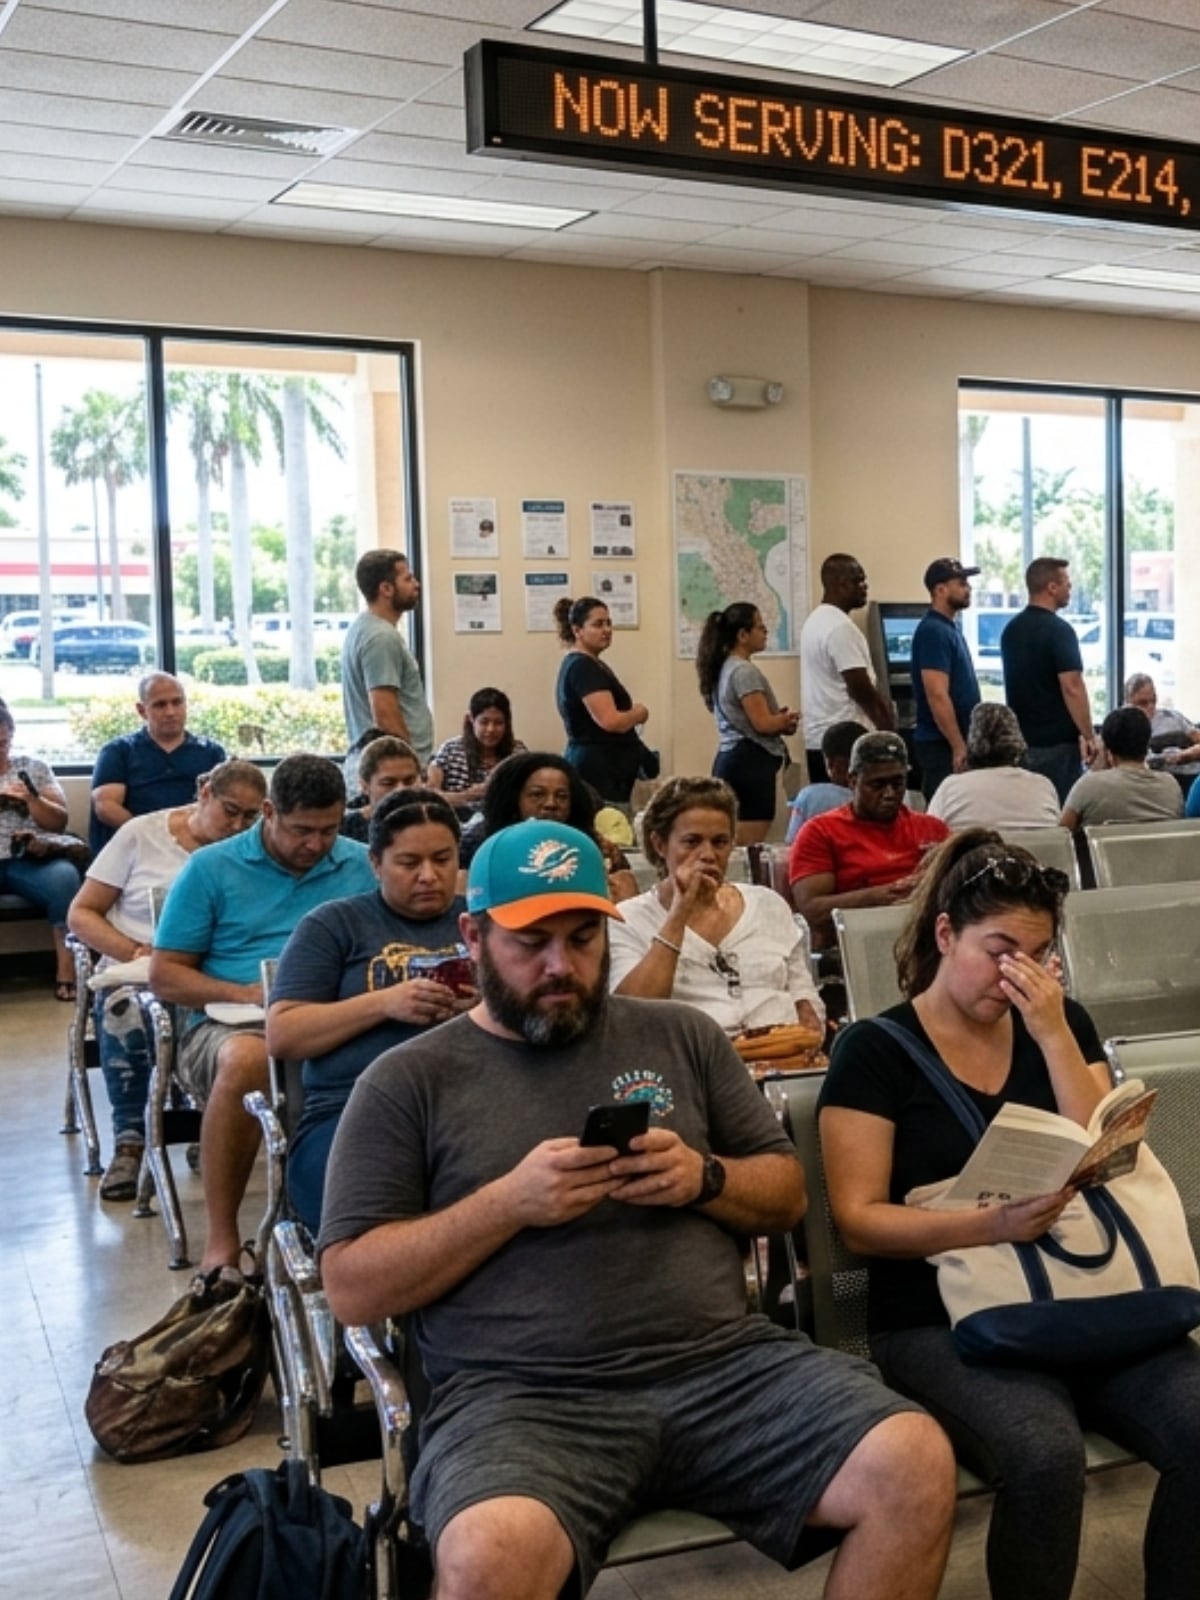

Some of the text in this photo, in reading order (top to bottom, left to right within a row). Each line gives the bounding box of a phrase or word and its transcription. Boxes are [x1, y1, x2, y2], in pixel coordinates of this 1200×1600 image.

[554, 72, 668, 142] NOW
[694, 93, 921, 173] SERVING:
[943, 127, 1062, 199] D321,
[1081, 146, 1191, 215] E214,
